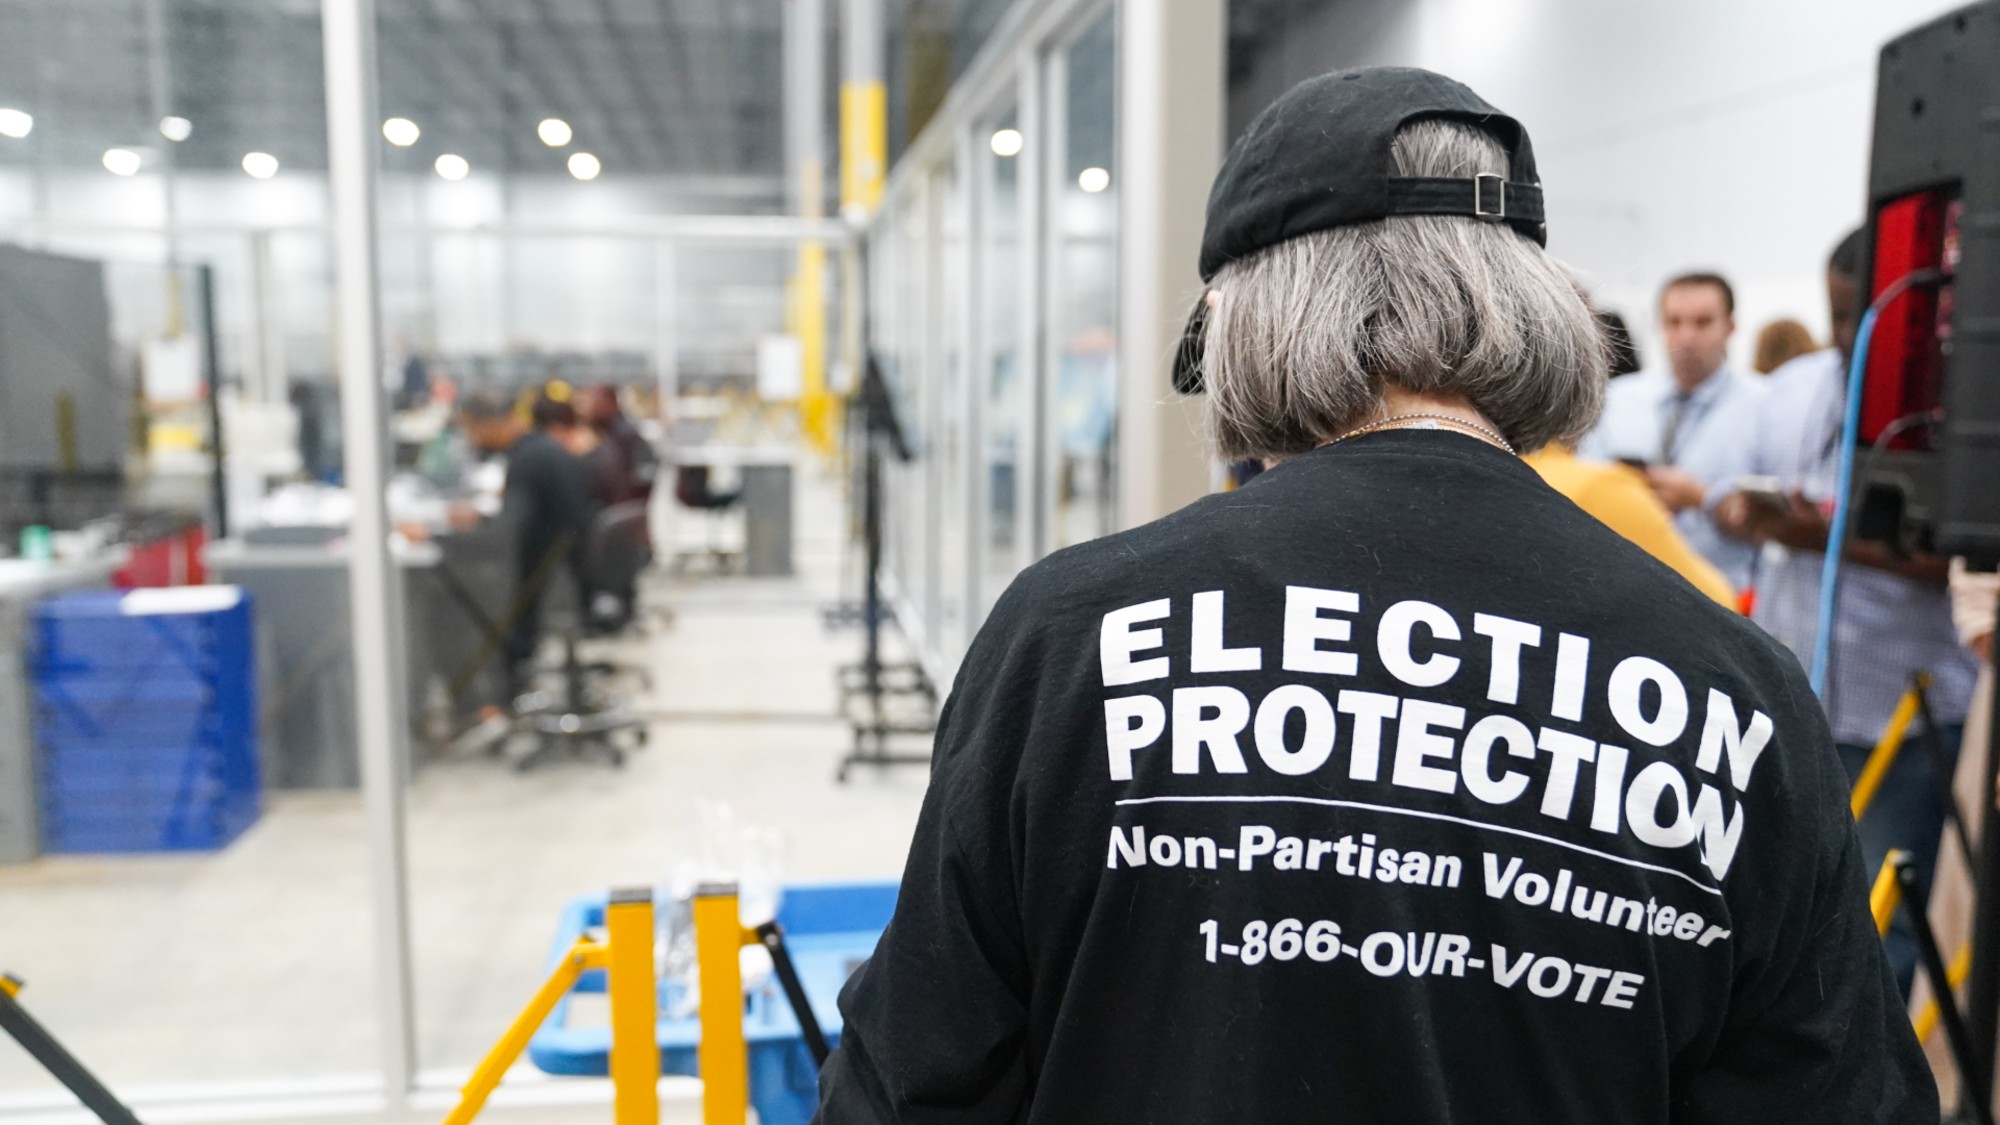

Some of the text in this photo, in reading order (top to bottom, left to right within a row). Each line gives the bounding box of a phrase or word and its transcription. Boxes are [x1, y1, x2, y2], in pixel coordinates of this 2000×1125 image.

[1099, 585, 1774, 792] ELECTION
[1103, 685, 1745, 881] PROTECTION
[1106, 825, 1731, 947] Non-Partisan Volunteer
[1199, 918, 1645, 1009] 1-866-OUR-VOTE
